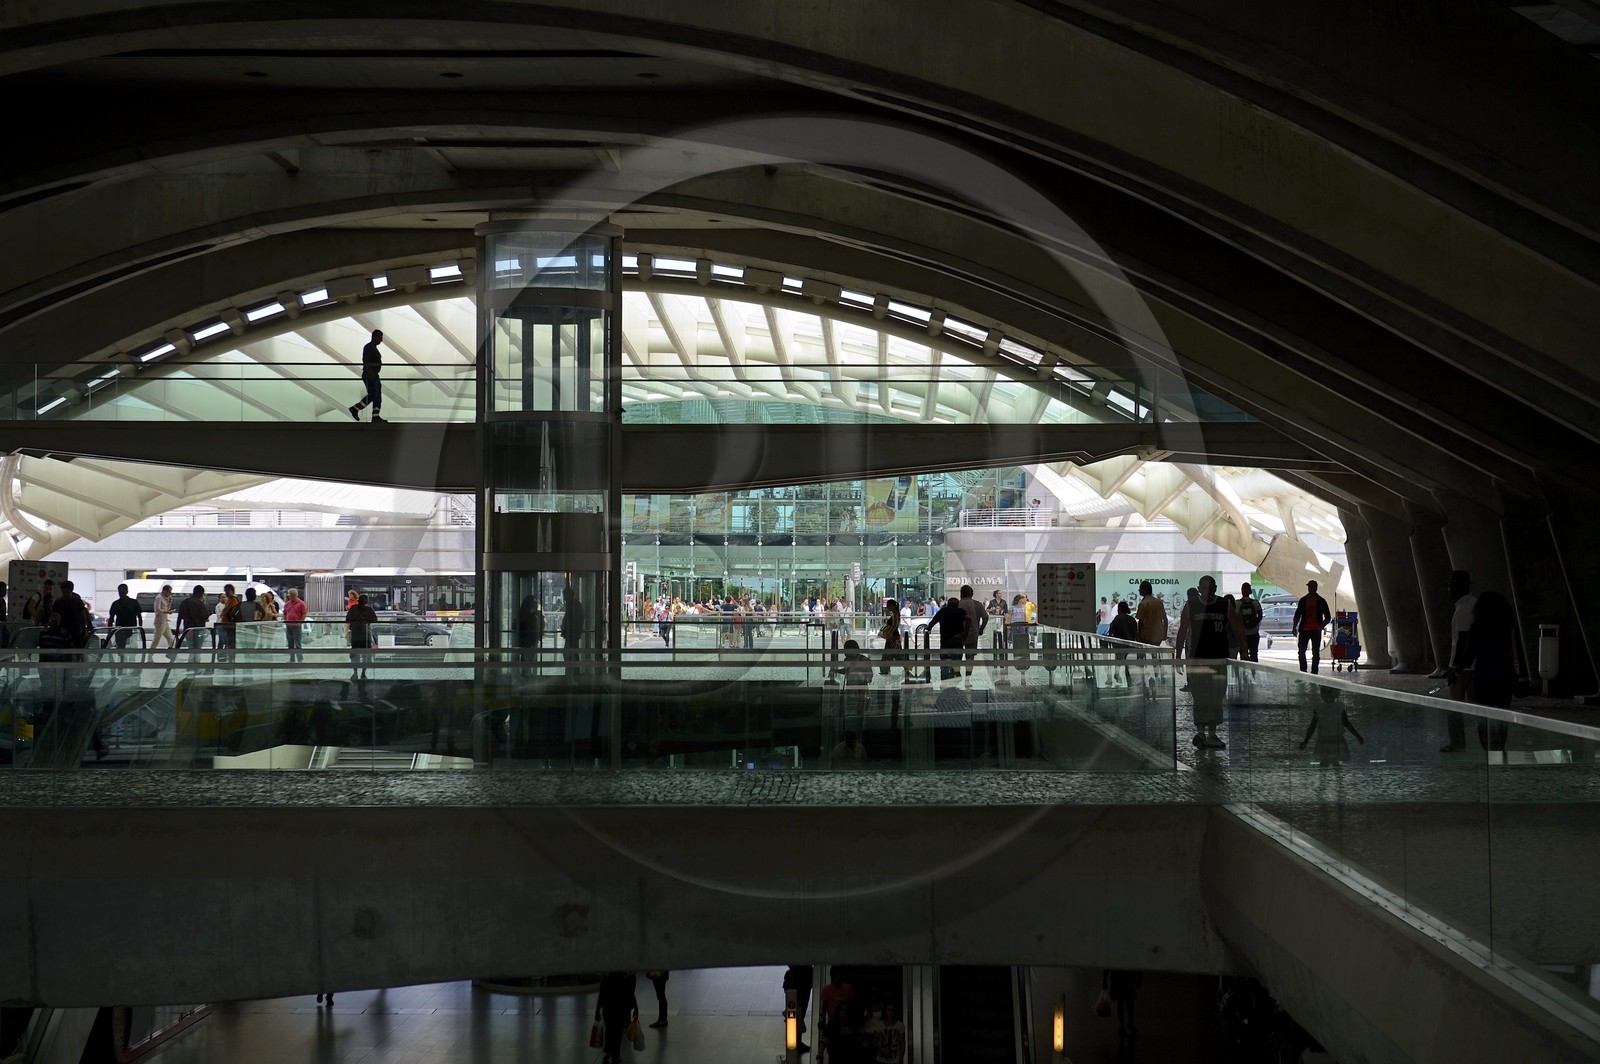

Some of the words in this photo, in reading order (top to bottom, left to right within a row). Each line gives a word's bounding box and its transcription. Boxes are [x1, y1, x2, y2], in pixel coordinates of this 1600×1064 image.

[961, 577, 972, 585] DA
[973, 577, 1003, 585] GAMA
[1214, 621, 1224, 632] 10
